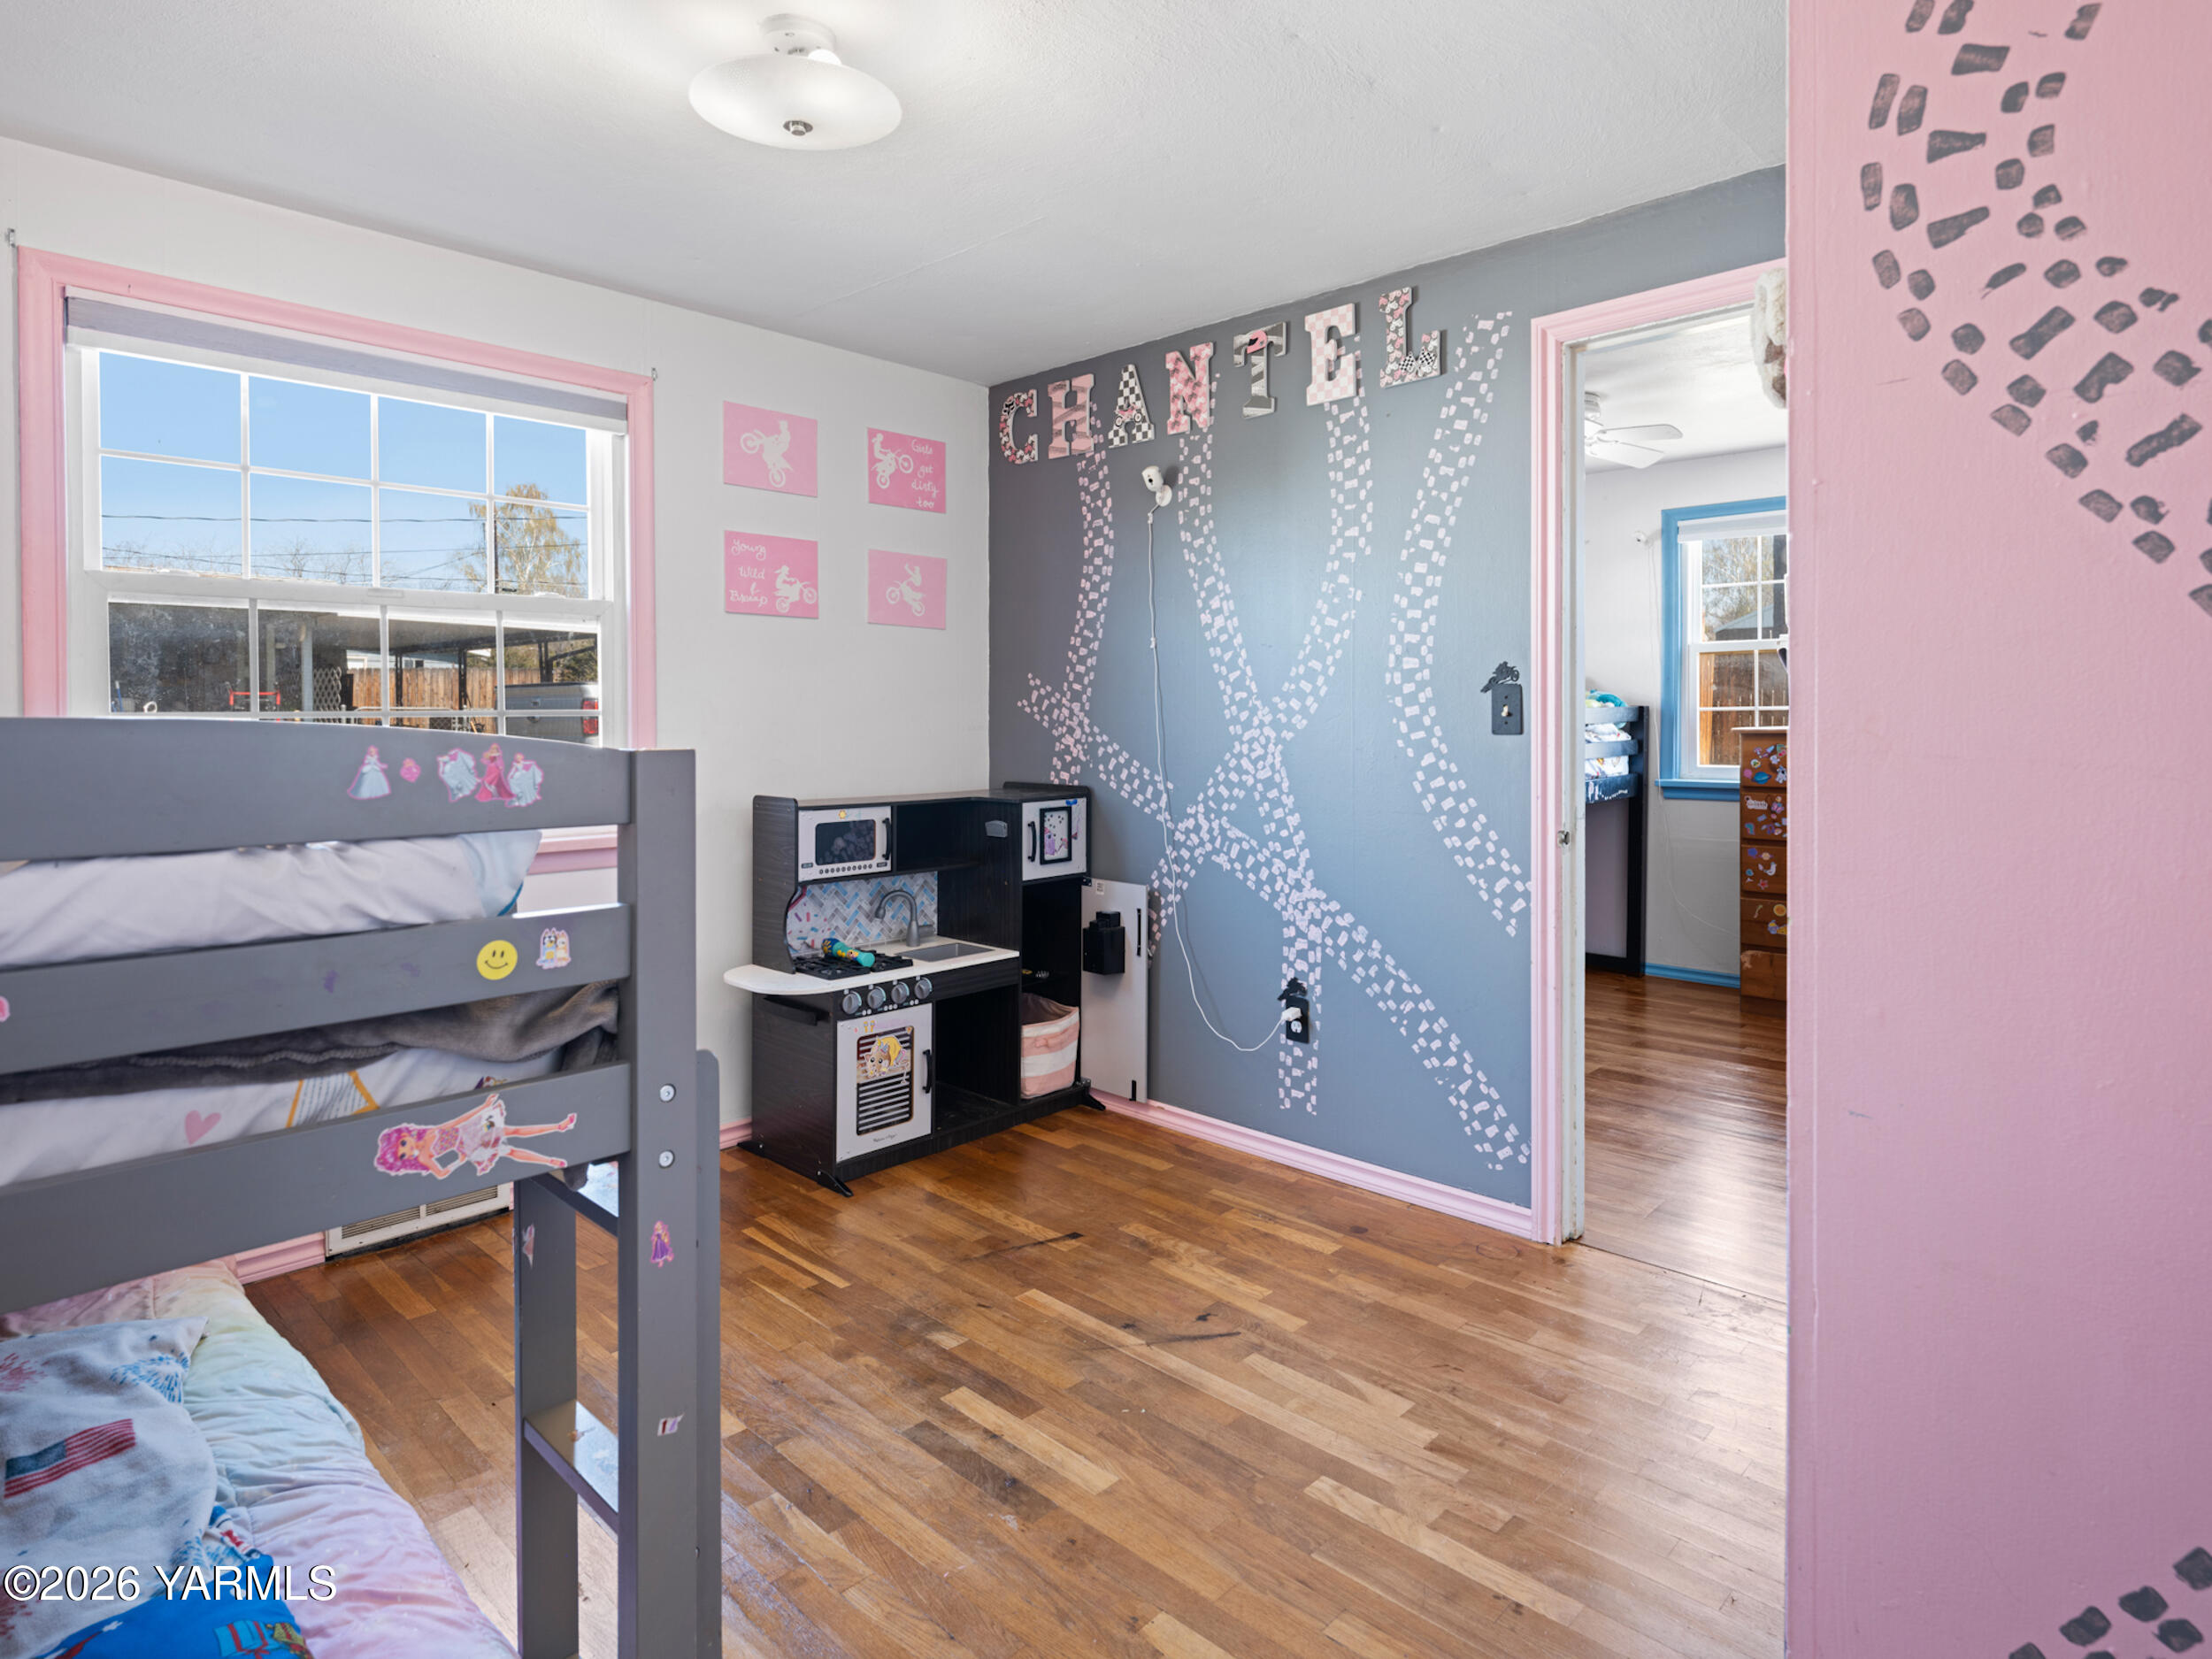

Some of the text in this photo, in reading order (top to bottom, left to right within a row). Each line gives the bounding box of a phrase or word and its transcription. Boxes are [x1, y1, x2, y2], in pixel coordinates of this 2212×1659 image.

[1000, 286, 1442, 465] CHANTEL
[918, 465, 934, 479] get
[910, 480, 940, 499] dirty
[916, 496, 935, 509] too
[737, 566, 765, 580] Wild
